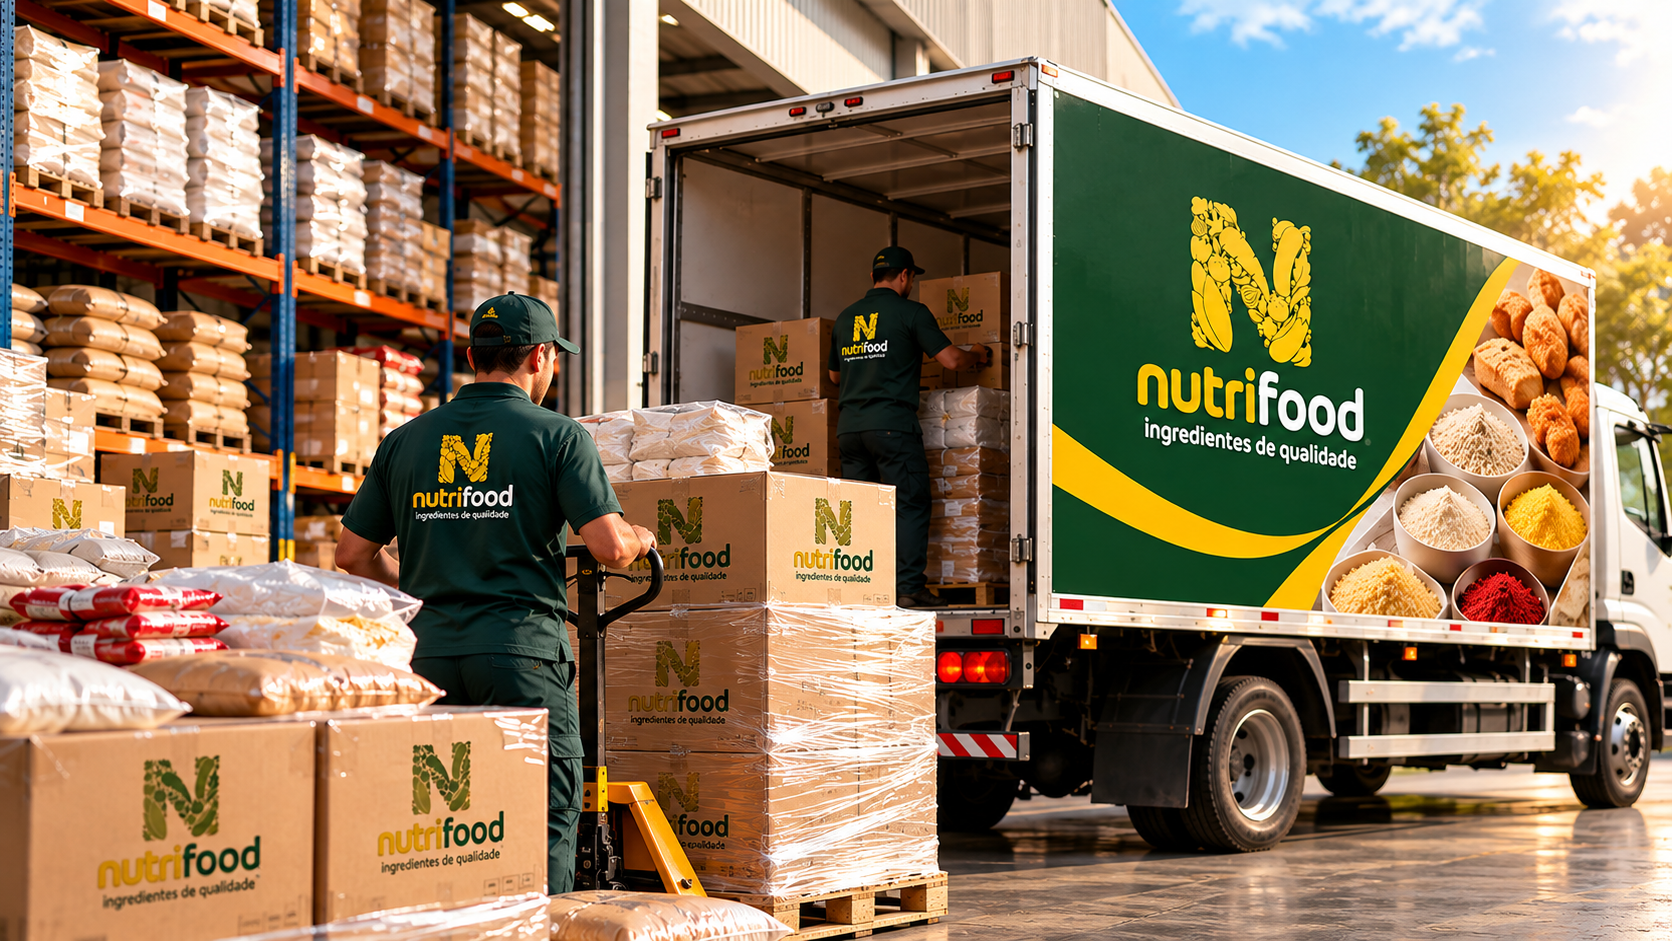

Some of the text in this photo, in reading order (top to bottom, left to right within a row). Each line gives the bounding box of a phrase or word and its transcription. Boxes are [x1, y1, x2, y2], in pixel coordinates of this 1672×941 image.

[1190, 196, 1312, 367] N
[946, 287, 970, 314] N
[852, 312, 879, 342] N
[763, 334, 788, 365] N
[841, 340, 888, 356] nutrifood
[749, 361, 804, 380] nutrifood
[1137, 363, 1365, 442] nutrifood
[438, 432, 494, 484] N
[1144, 417, 1357, 470] ingredientes de qualidade
[132, 467, 159, 494] N
[222, 469, 243, 497] N
[209, 497, 255, 511] nutrifood
[412, 484, 514, 508] nutrifood
[415, 510, 459, 522] ingredientes
[461, 511, 471, 519] de
[657, 496, 703, 545] N
[815, 498, 852, 546] N
[793, 548, 873, 572] nutrifood
[679, 573, 689, 581] de
[833, 573, 842, 582] de
[655, 640, 700, 687] N
[628, 688, 729, 712] nutrifood
[630, 715, 726, 726] ingredientes de qualidade
[412, 741, 471, 815] N
[658, 771, 700, 812] N
[143, 755, 220, 841] N
[377, 811, 505, 857] nutrifood
[97, 835, 261, 889] nutrifood
[381, 848, 501, 875] ingredientes de qualidade
[102, 877, 255, 911] ingredientes de qualidade
